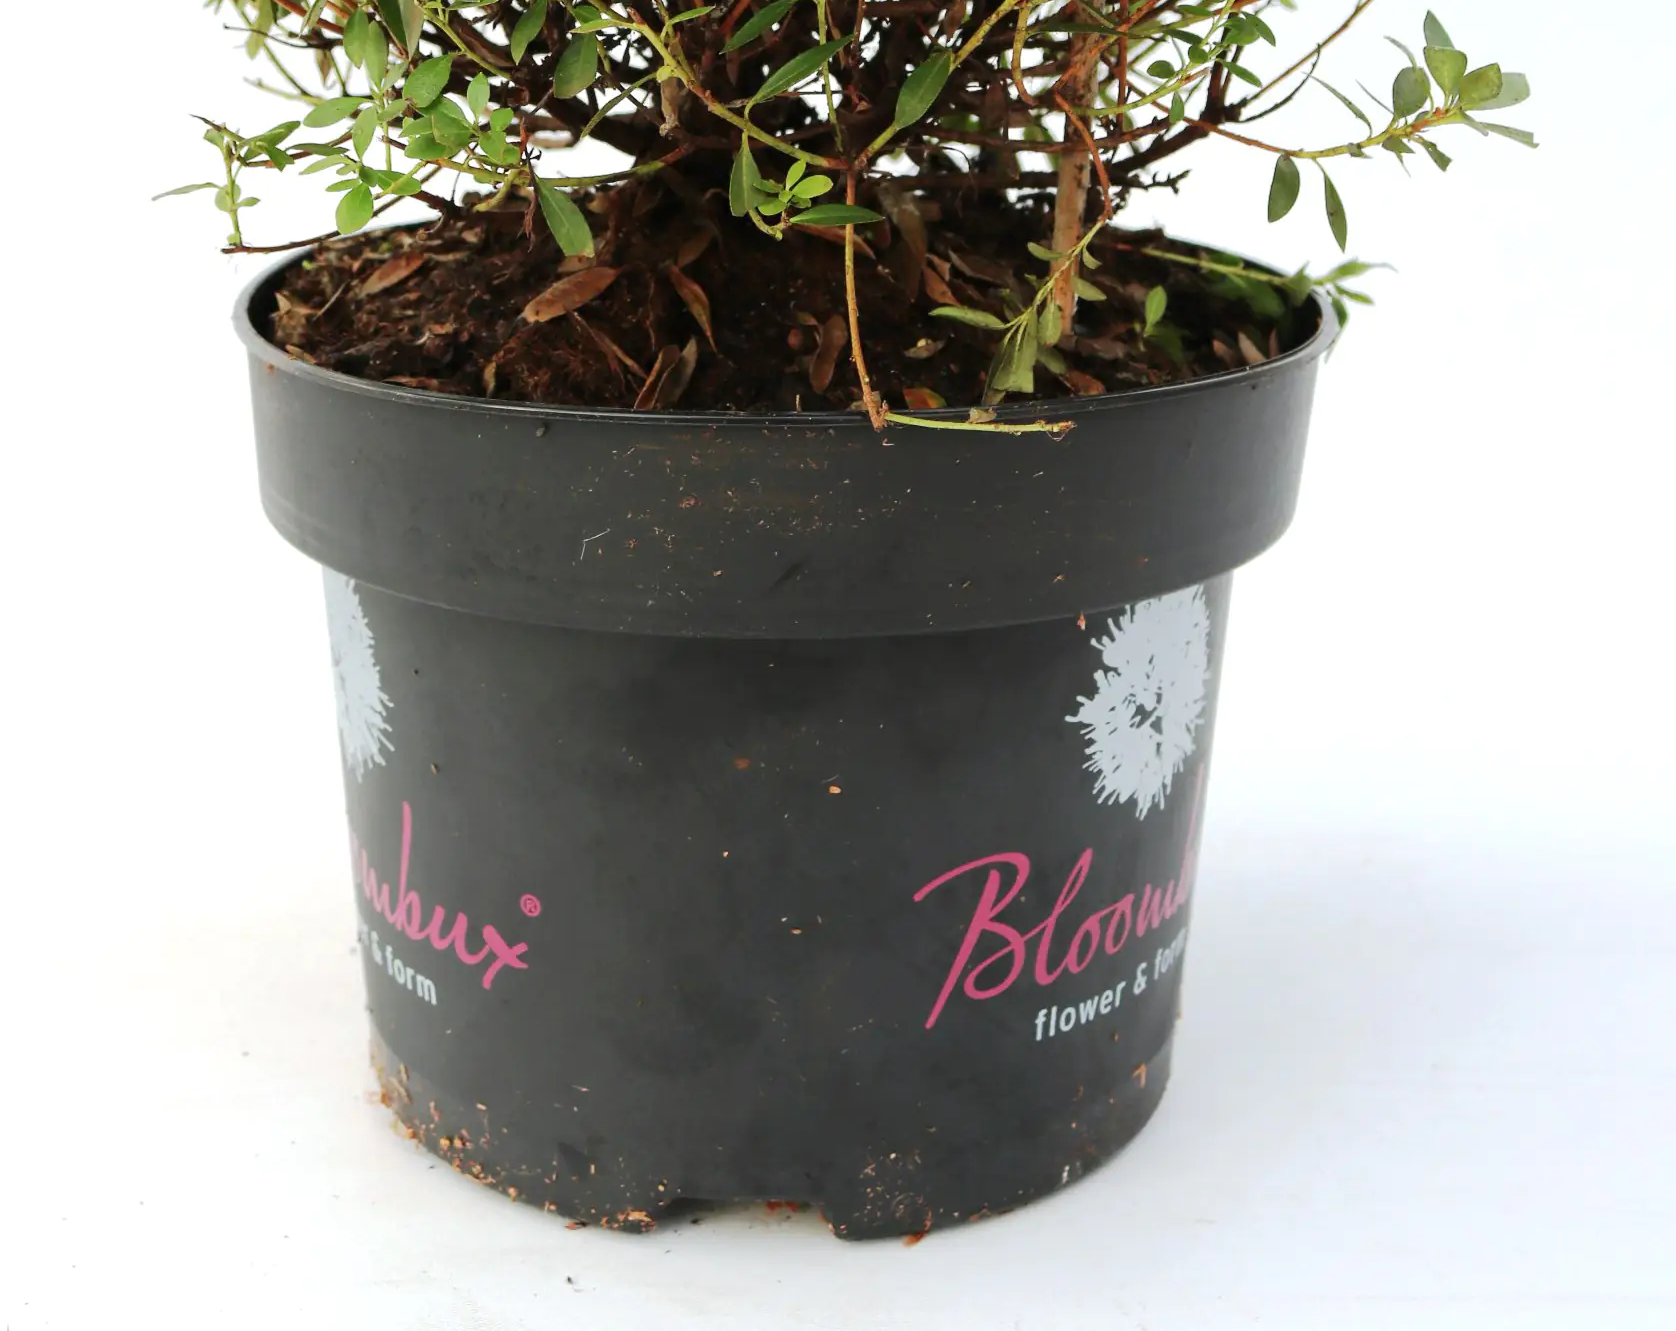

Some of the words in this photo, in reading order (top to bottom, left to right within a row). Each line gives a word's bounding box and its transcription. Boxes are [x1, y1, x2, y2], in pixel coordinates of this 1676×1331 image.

[385, 944, 438, 1006] form
[1034, 980, 1127, 1041] flower
[1133, 961, 1148, 996] &
